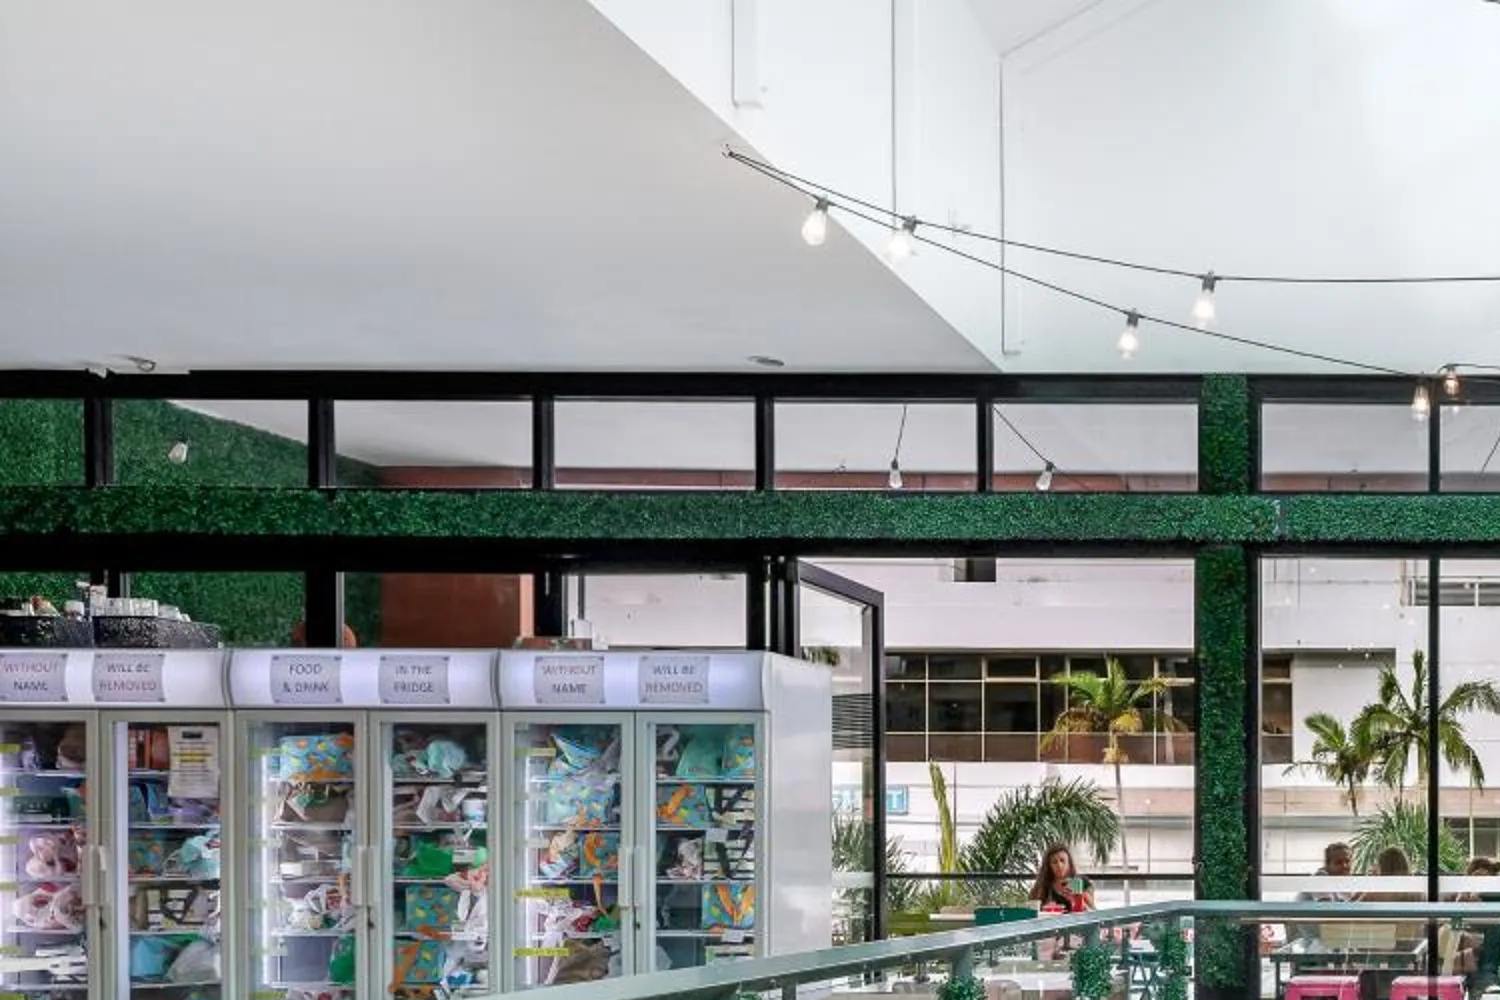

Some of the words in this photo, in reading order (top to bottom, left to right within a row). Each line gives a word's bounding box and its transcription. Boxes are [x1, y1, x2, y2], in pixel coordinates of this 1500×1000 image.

[3, 661, 58, 673] WITHOUT
[106, 662, 132, 673] WILL
[136, 662, 151, 673] BE
[288, 663, 323, 675] FOOD
[395, 665, 408, 675] IN
[411, 665, 432, 675] THE
[541, 664, 597, 676] WITHOUT
[653, 665, 678, 675] WILL
[682, 665, 695, 675] BE
[13, 681, 48, 691] NAME
[99, 681, 157, 692] REMOVED
[295, 682, 329, 693] DRINK
[393, 682, 434, 693] FRIDGE
[552, 683, 588, 694] NAME
[644, 682, 703, 694] REMOVED
